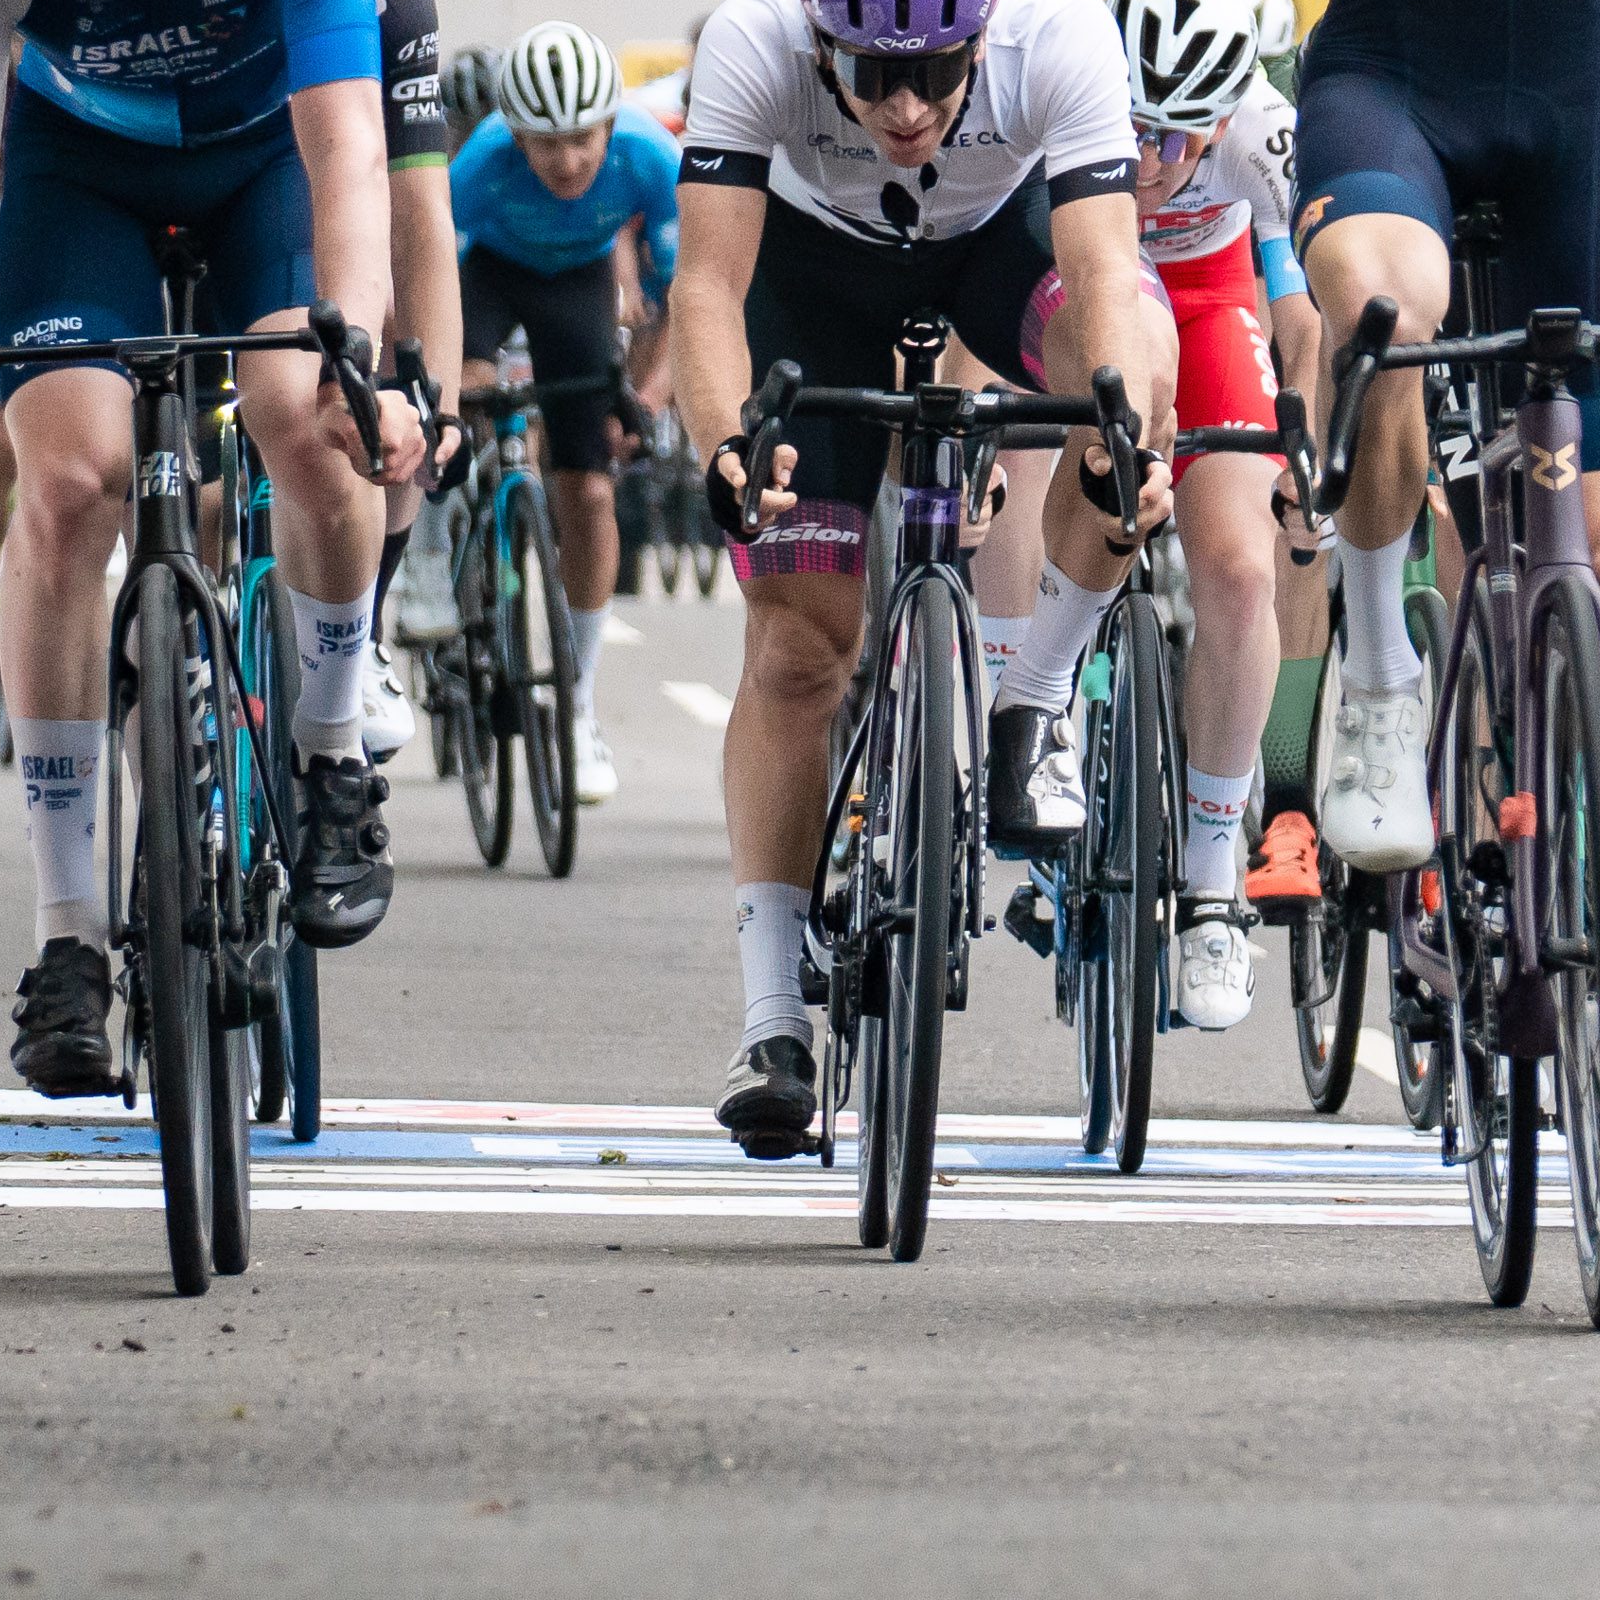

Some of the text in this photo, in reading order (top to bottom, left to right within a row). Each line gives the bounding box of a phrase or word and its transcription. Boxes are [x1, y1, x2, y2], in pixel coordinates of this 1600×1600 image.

[72, 25, 200, 61] ISRAEL
[13, 317, 83, 347] RACING
[22, 756, 76, 780] ISRAEL
